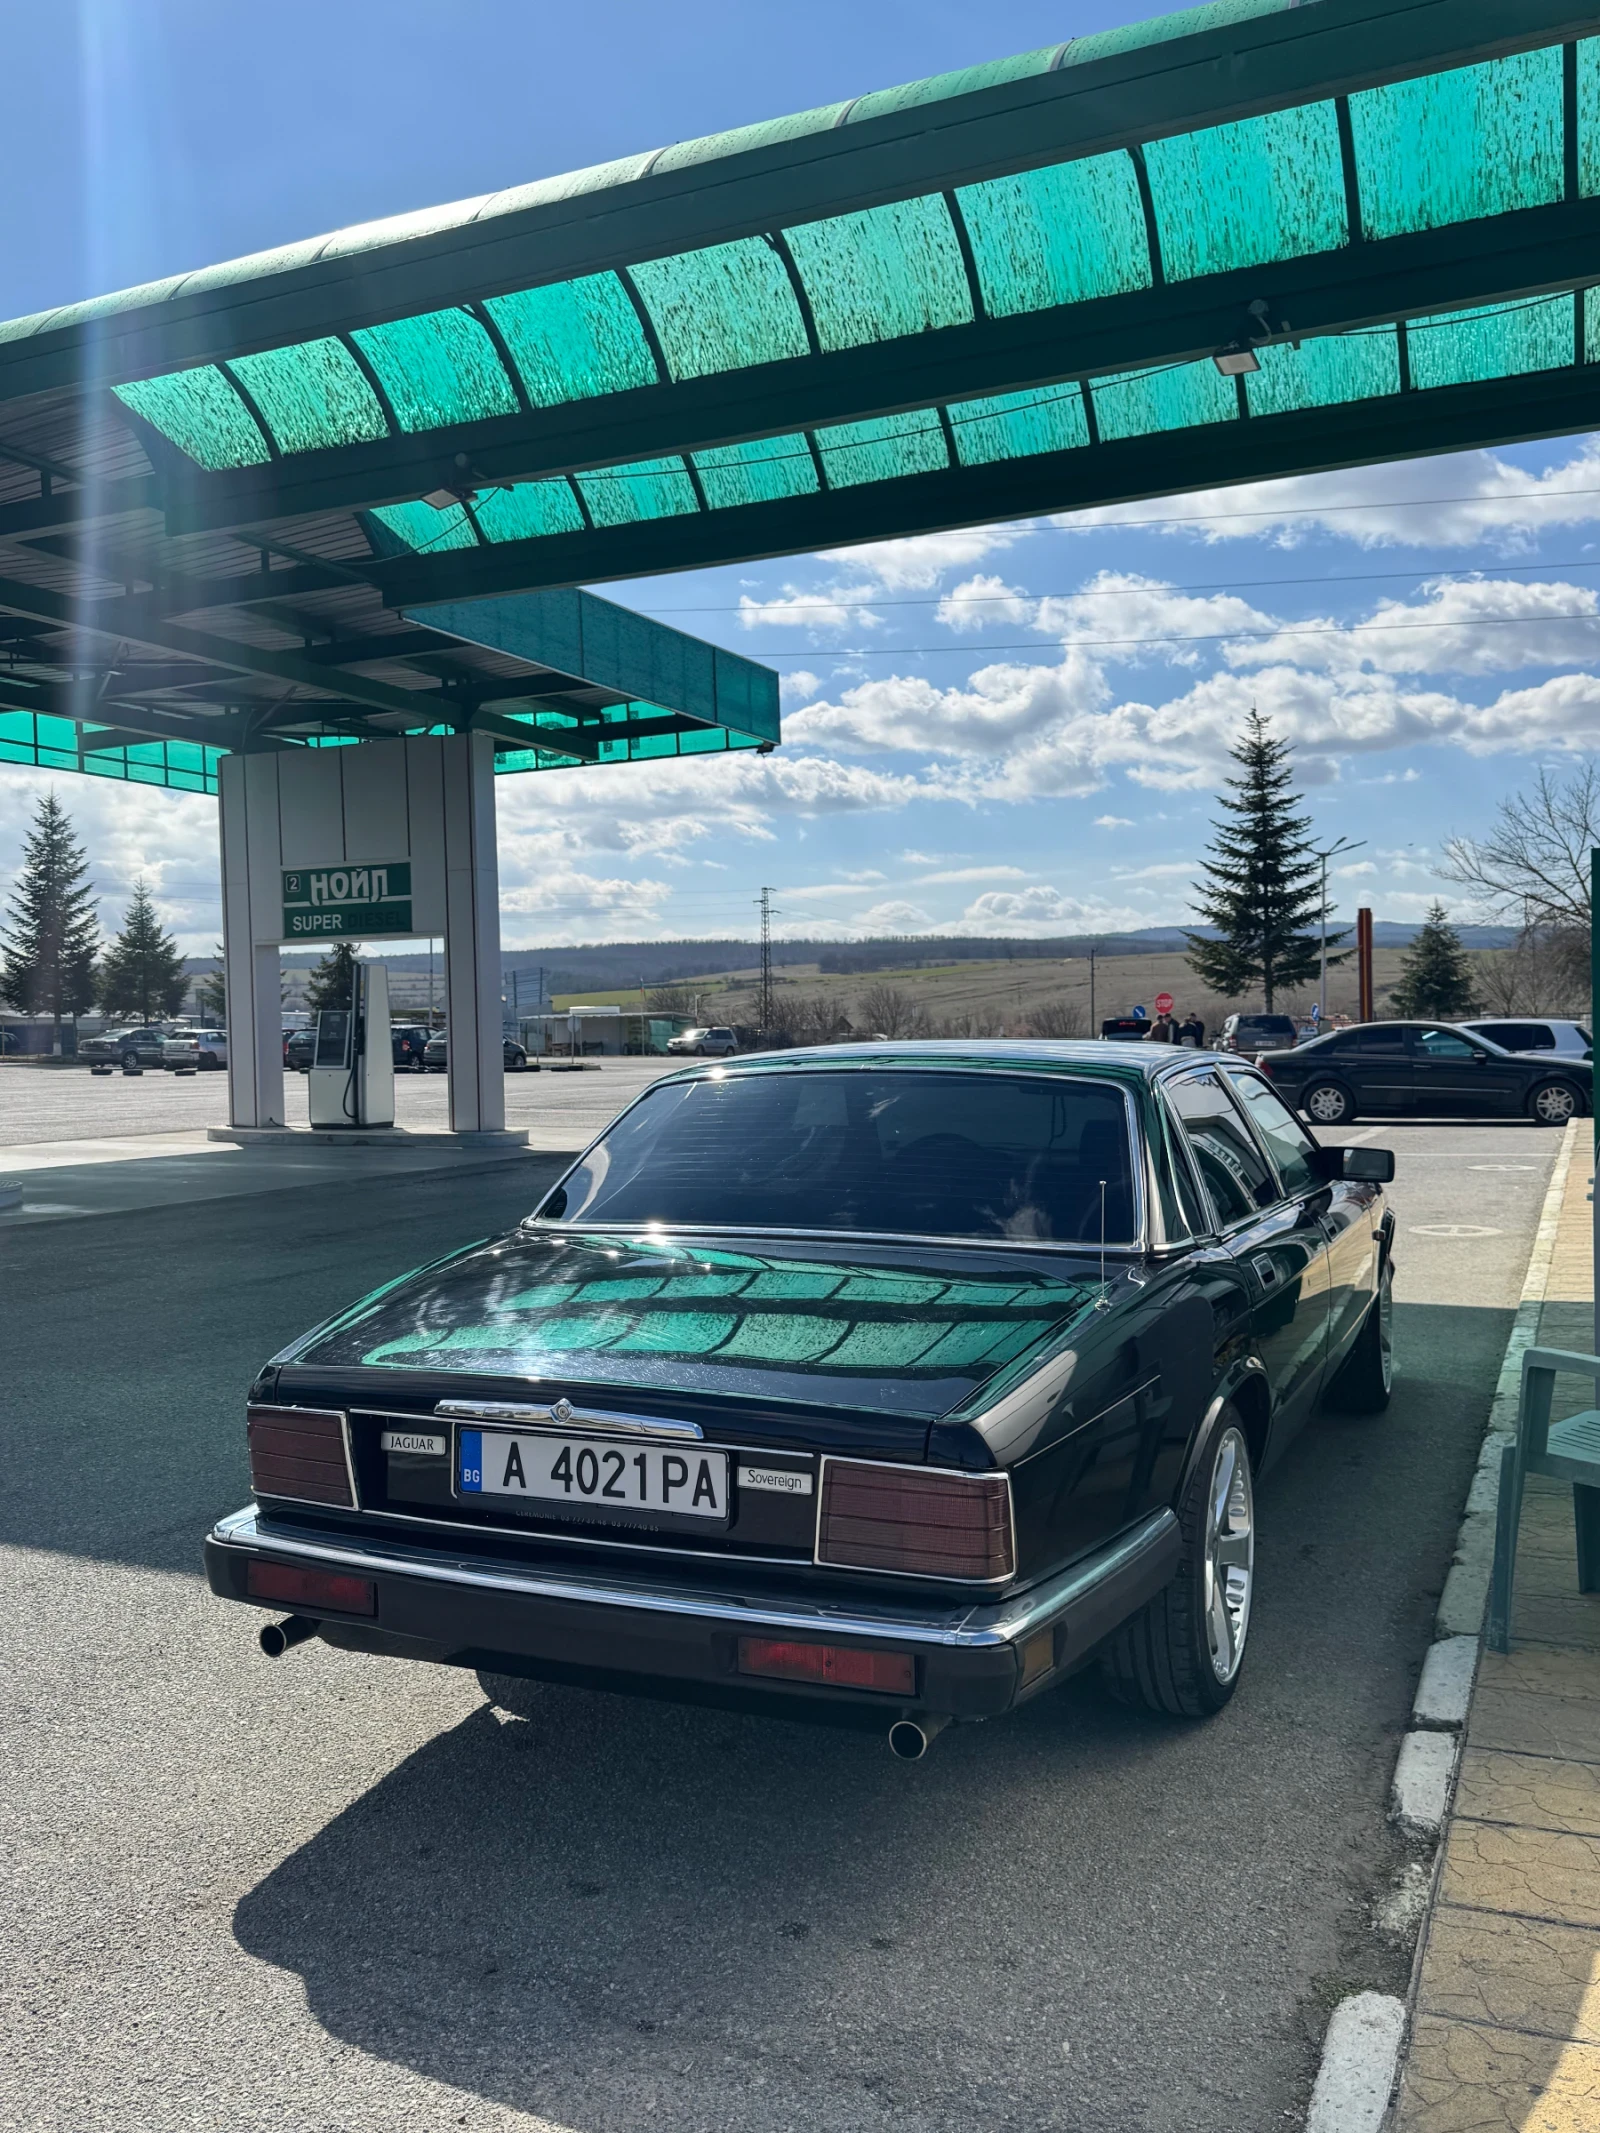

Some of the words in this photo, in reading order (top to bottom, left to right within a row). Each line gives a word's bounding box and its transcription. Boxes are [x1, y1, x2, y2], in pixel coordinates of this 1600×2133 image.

[289, 877, 298, 890] 2
[293, 914, 343, 931] SUPER
[348, 911, 405, 928] DIESEL
[1157, 998, 1173, 1008] STOP
[391, 1436, 434, 1451] JAGUAR
[502, 1441, 527, 1489] A
[464, 1468, 480, 1483] BG
[747, 1469, 802, 1491] Sovereign
